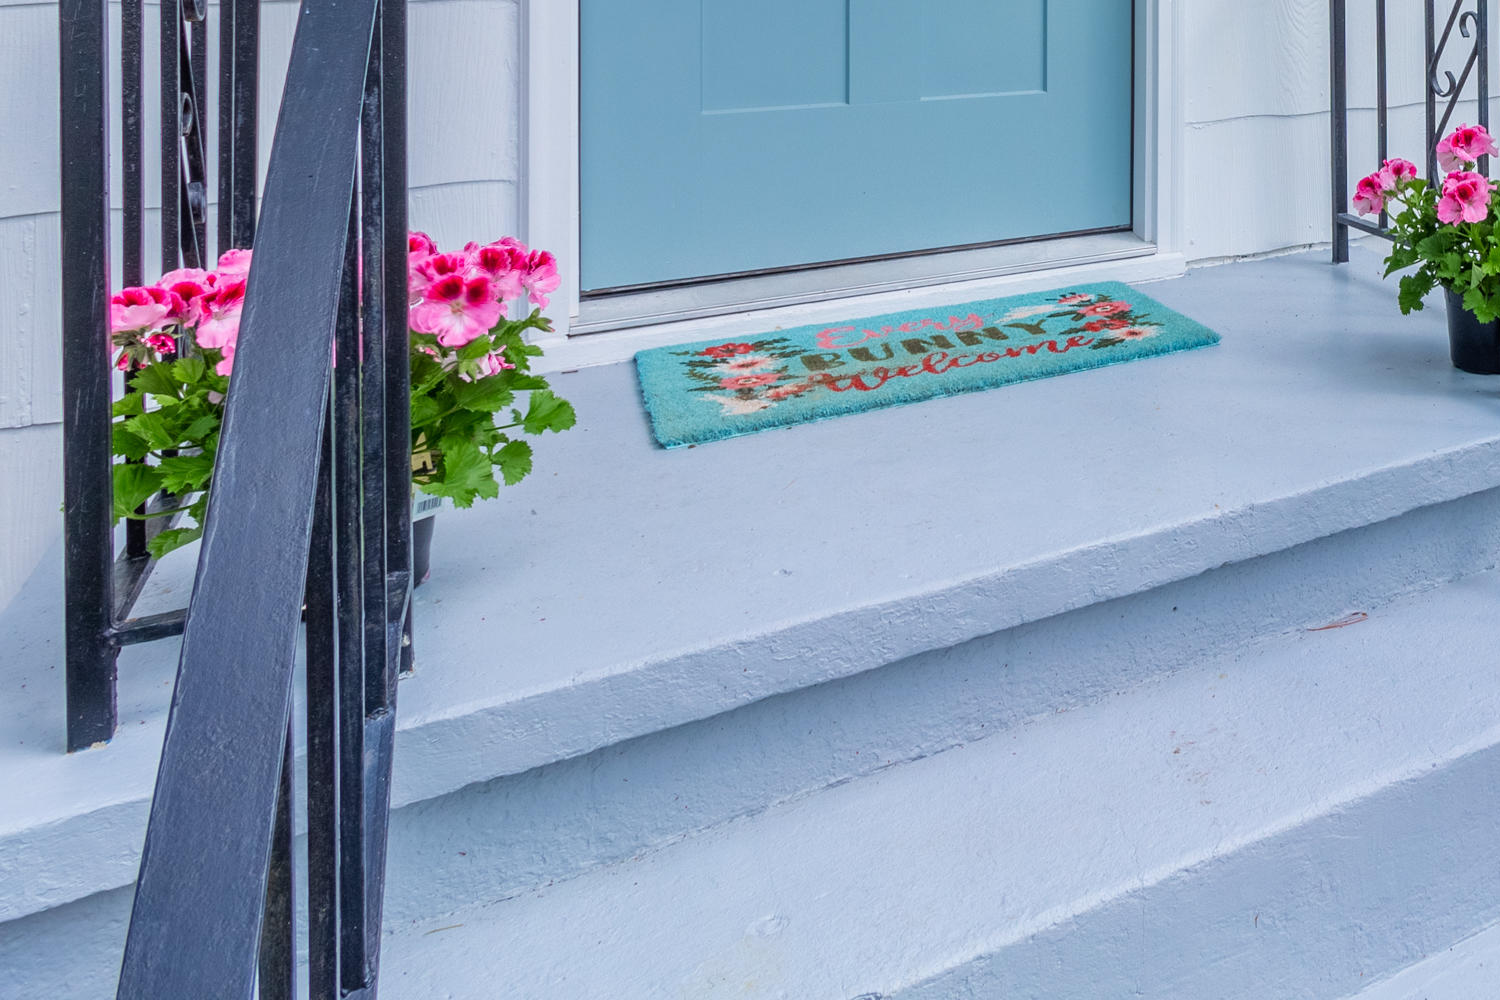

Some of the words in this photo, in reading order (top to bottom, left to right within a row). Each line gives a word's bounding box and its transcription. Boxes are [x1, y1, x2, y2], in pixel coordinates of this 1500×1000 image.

[800, 319, 1047, 371] BUNNY
[815, 313, 991, 349] Every
[808, 335, 1095, 392] Welcome
